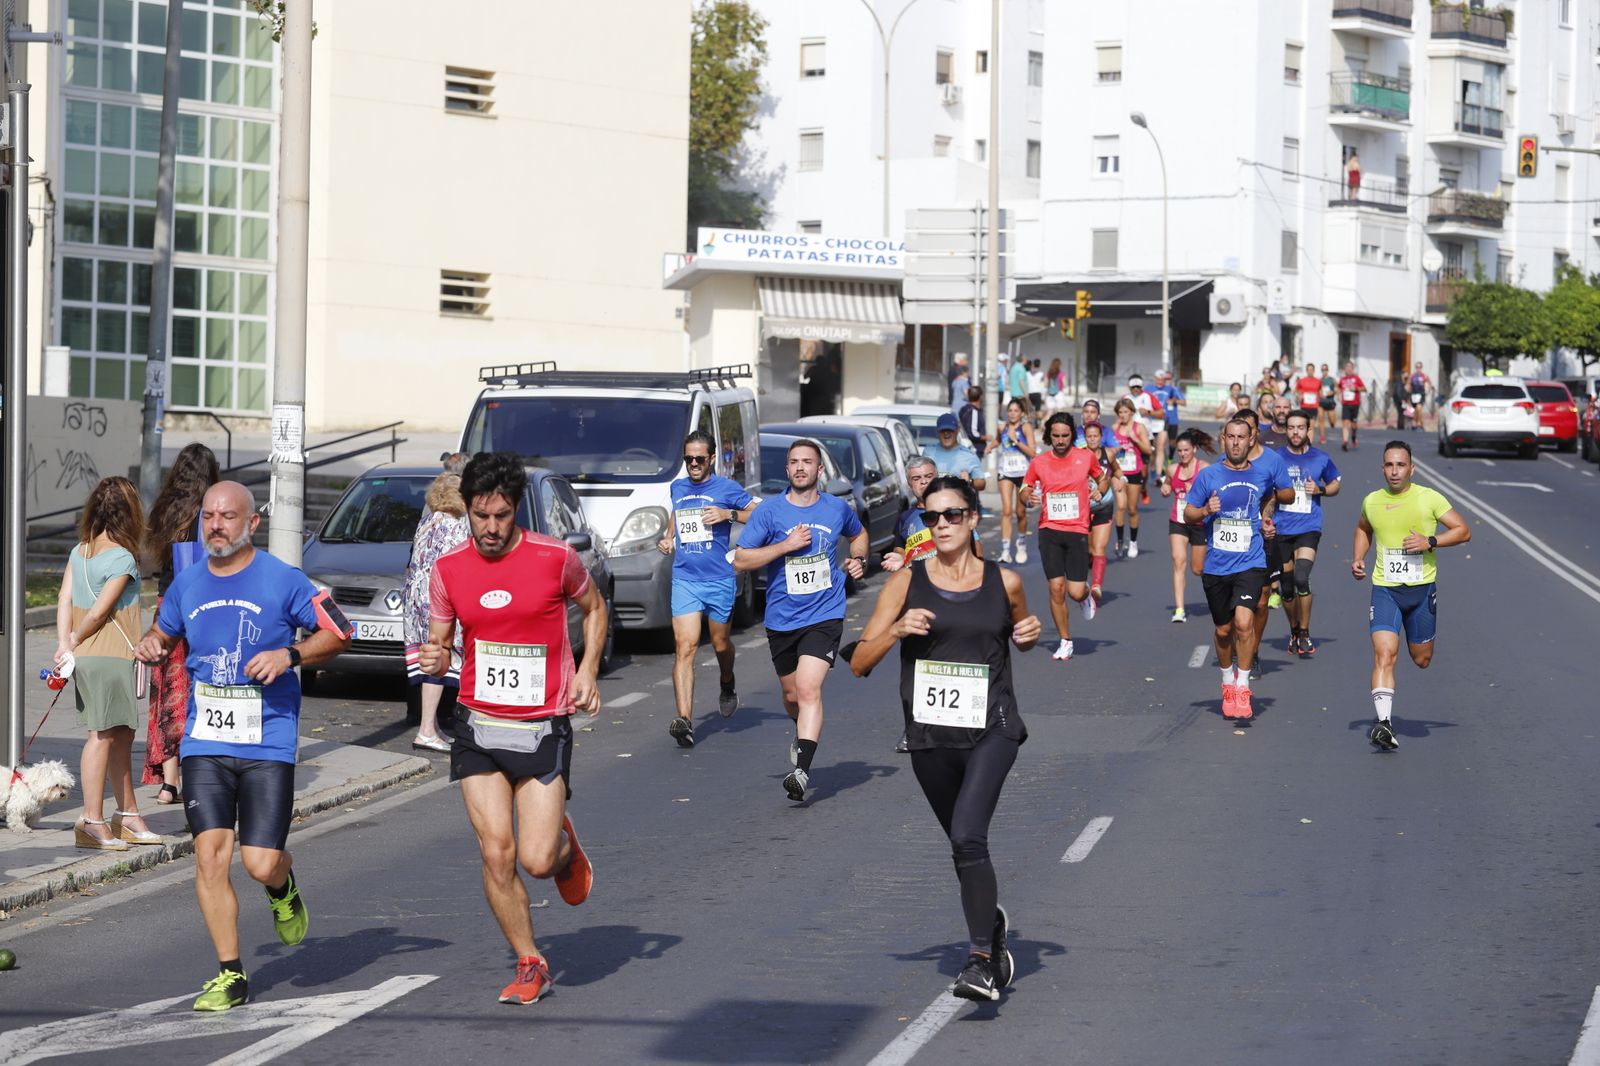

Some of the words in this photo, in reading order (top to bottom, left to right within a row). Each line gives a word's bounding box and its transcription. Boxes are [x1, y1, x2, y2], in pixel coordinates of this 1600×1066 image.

[723, 232, 808, 246] CHURROS
[747, 248, 829, 261] PATATAS
[835, 252, 898, 265] FRITAS
[1052, 503, 1067, 513] 601
[680, 521, 698, 534] 298
[1219, 530, 1238, 543] 203
[1389, 561, 1409, 573] 324
[794, 570, 816, 584] 187
[361, 624, 394, 638] 9244
[488, 645, 510, 655] VUELTA
[511, 647, 517, 656] A
[518, 647, 541, 657] HUELVA
[928, 664, 952, 675] VUELTA
[952, 666, 958, 675] A
[959, 666, 983, 677] HUELVA
[486, 666, 519, 689] 513
[205, 686, 225, 697] VUELTA
[226, 689, 231, 697] A
[232, 689, 257, 698] HUELVA
[926, 686, 960, 709] 512
[205, 708, 236, 730] 234
